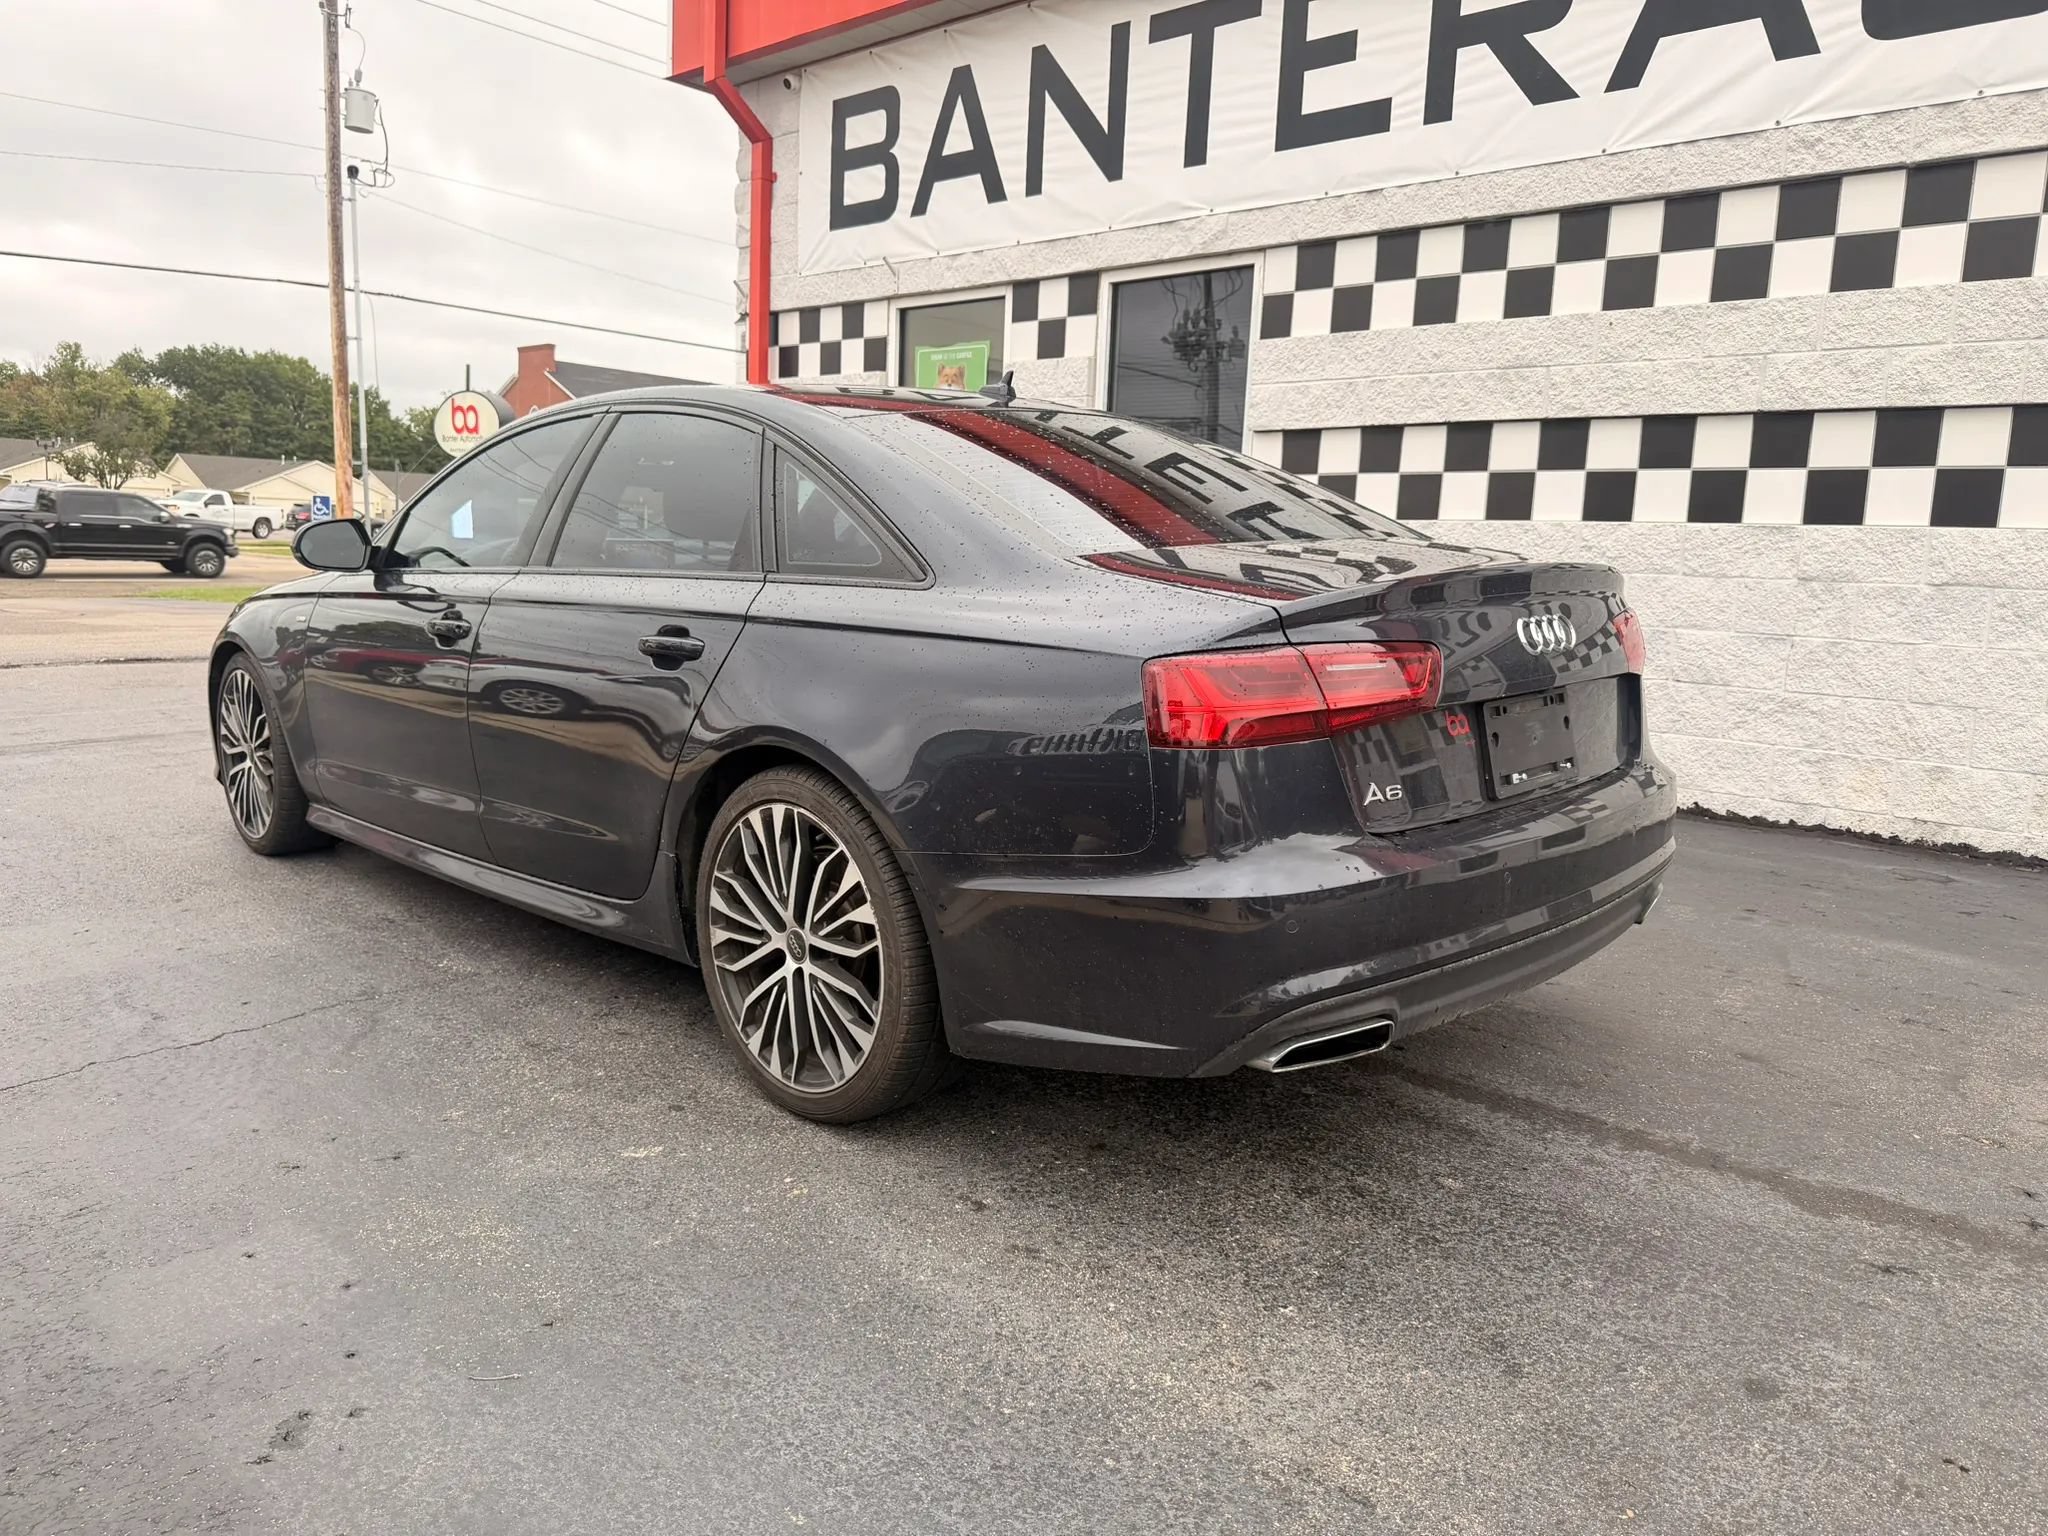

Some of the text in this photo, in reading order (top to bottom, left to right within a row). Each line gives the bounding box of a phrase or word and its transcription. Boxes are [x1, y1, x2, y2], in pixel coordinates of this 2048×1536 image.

[829, 0, 2048, 232] BANTER
[451, 398, 479, 434] ba
[1445, 710, 1471, 737] ba
[1363, 782, 1402, 806] A6
